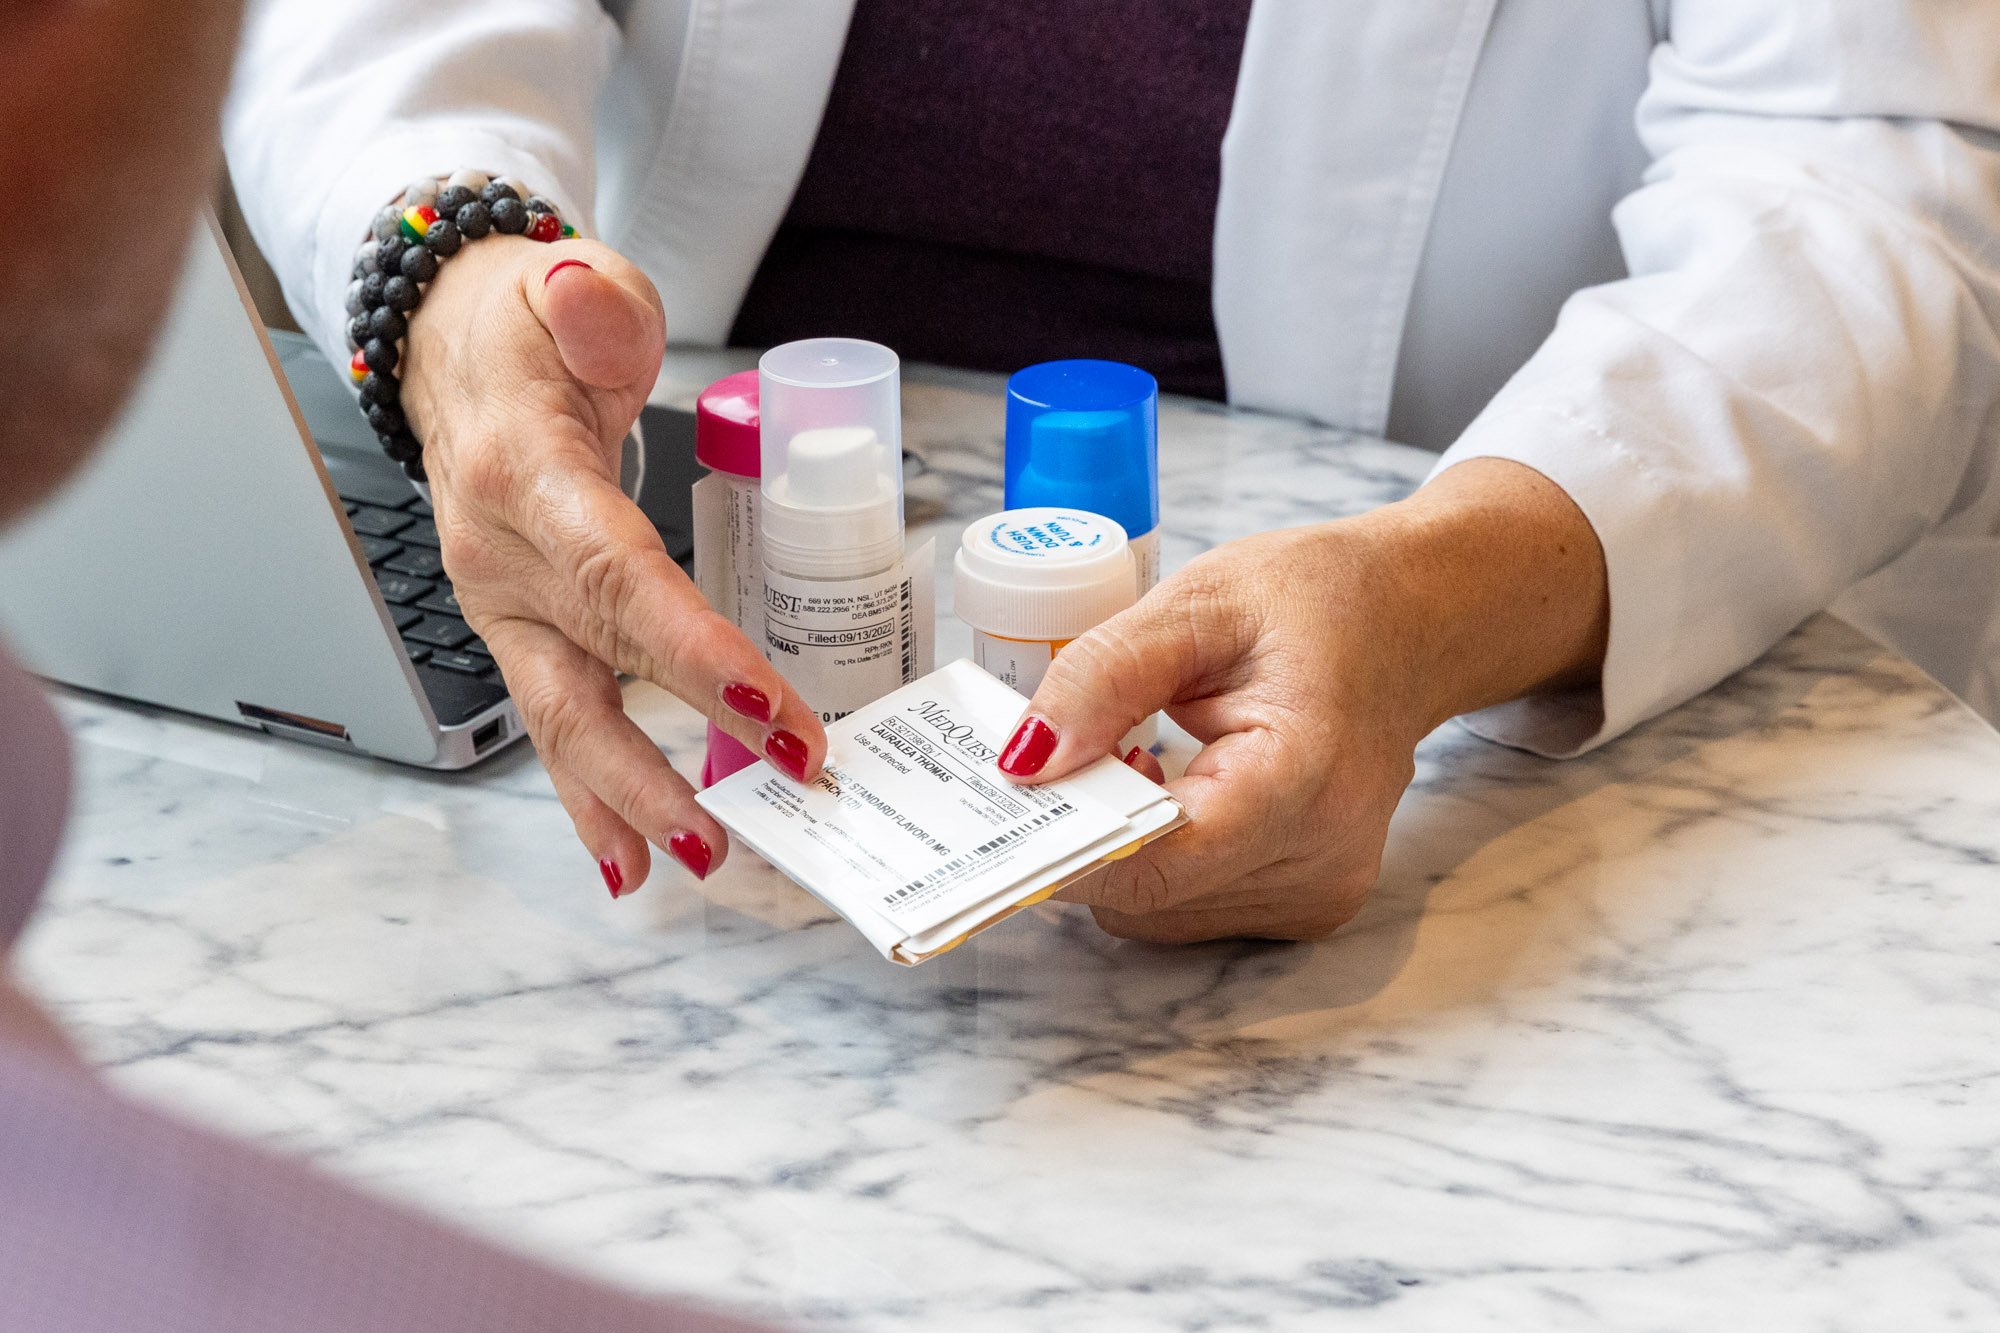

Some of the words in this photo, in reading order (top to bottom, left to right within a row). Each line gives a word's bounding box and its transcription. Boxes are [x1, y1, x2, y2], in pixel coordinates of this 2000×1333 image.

[1005, 530, 1040, 551] PUSH
[1023, 526, 1060, 549] DOWN
[1042, 521, 1076, 542] TURN
[874, 590, 883, 598] UT
[851, 610, 867, 620] DEA
[808, 622, 892, 644] Filled:09/13/2022
[833, 659, 846, 667] Org
[822, 712, 831, 722] 0
[854, 733, 872, 747] Use
[868, 743, 882, 754] as
[878, 748, 912, 775] directed
[870, 724, 917, 759] LAURALEA
[914, 755, 953, 783] THOMAS
[883, 717, 897, 730] Rx
[895, 723, 924, 747] 5217398
[921, 742, 937, 757] Qty
[965, 776, 1025, 815] Filled:09/13/2022
[813, 777, 845, 798] (PACK
[848, 782, 897, 817] STANDARD
[891, 814, 930, 841] FLAVOR
[925, 838, 936, 846] 0
[931, 843, 951, 857] MG
